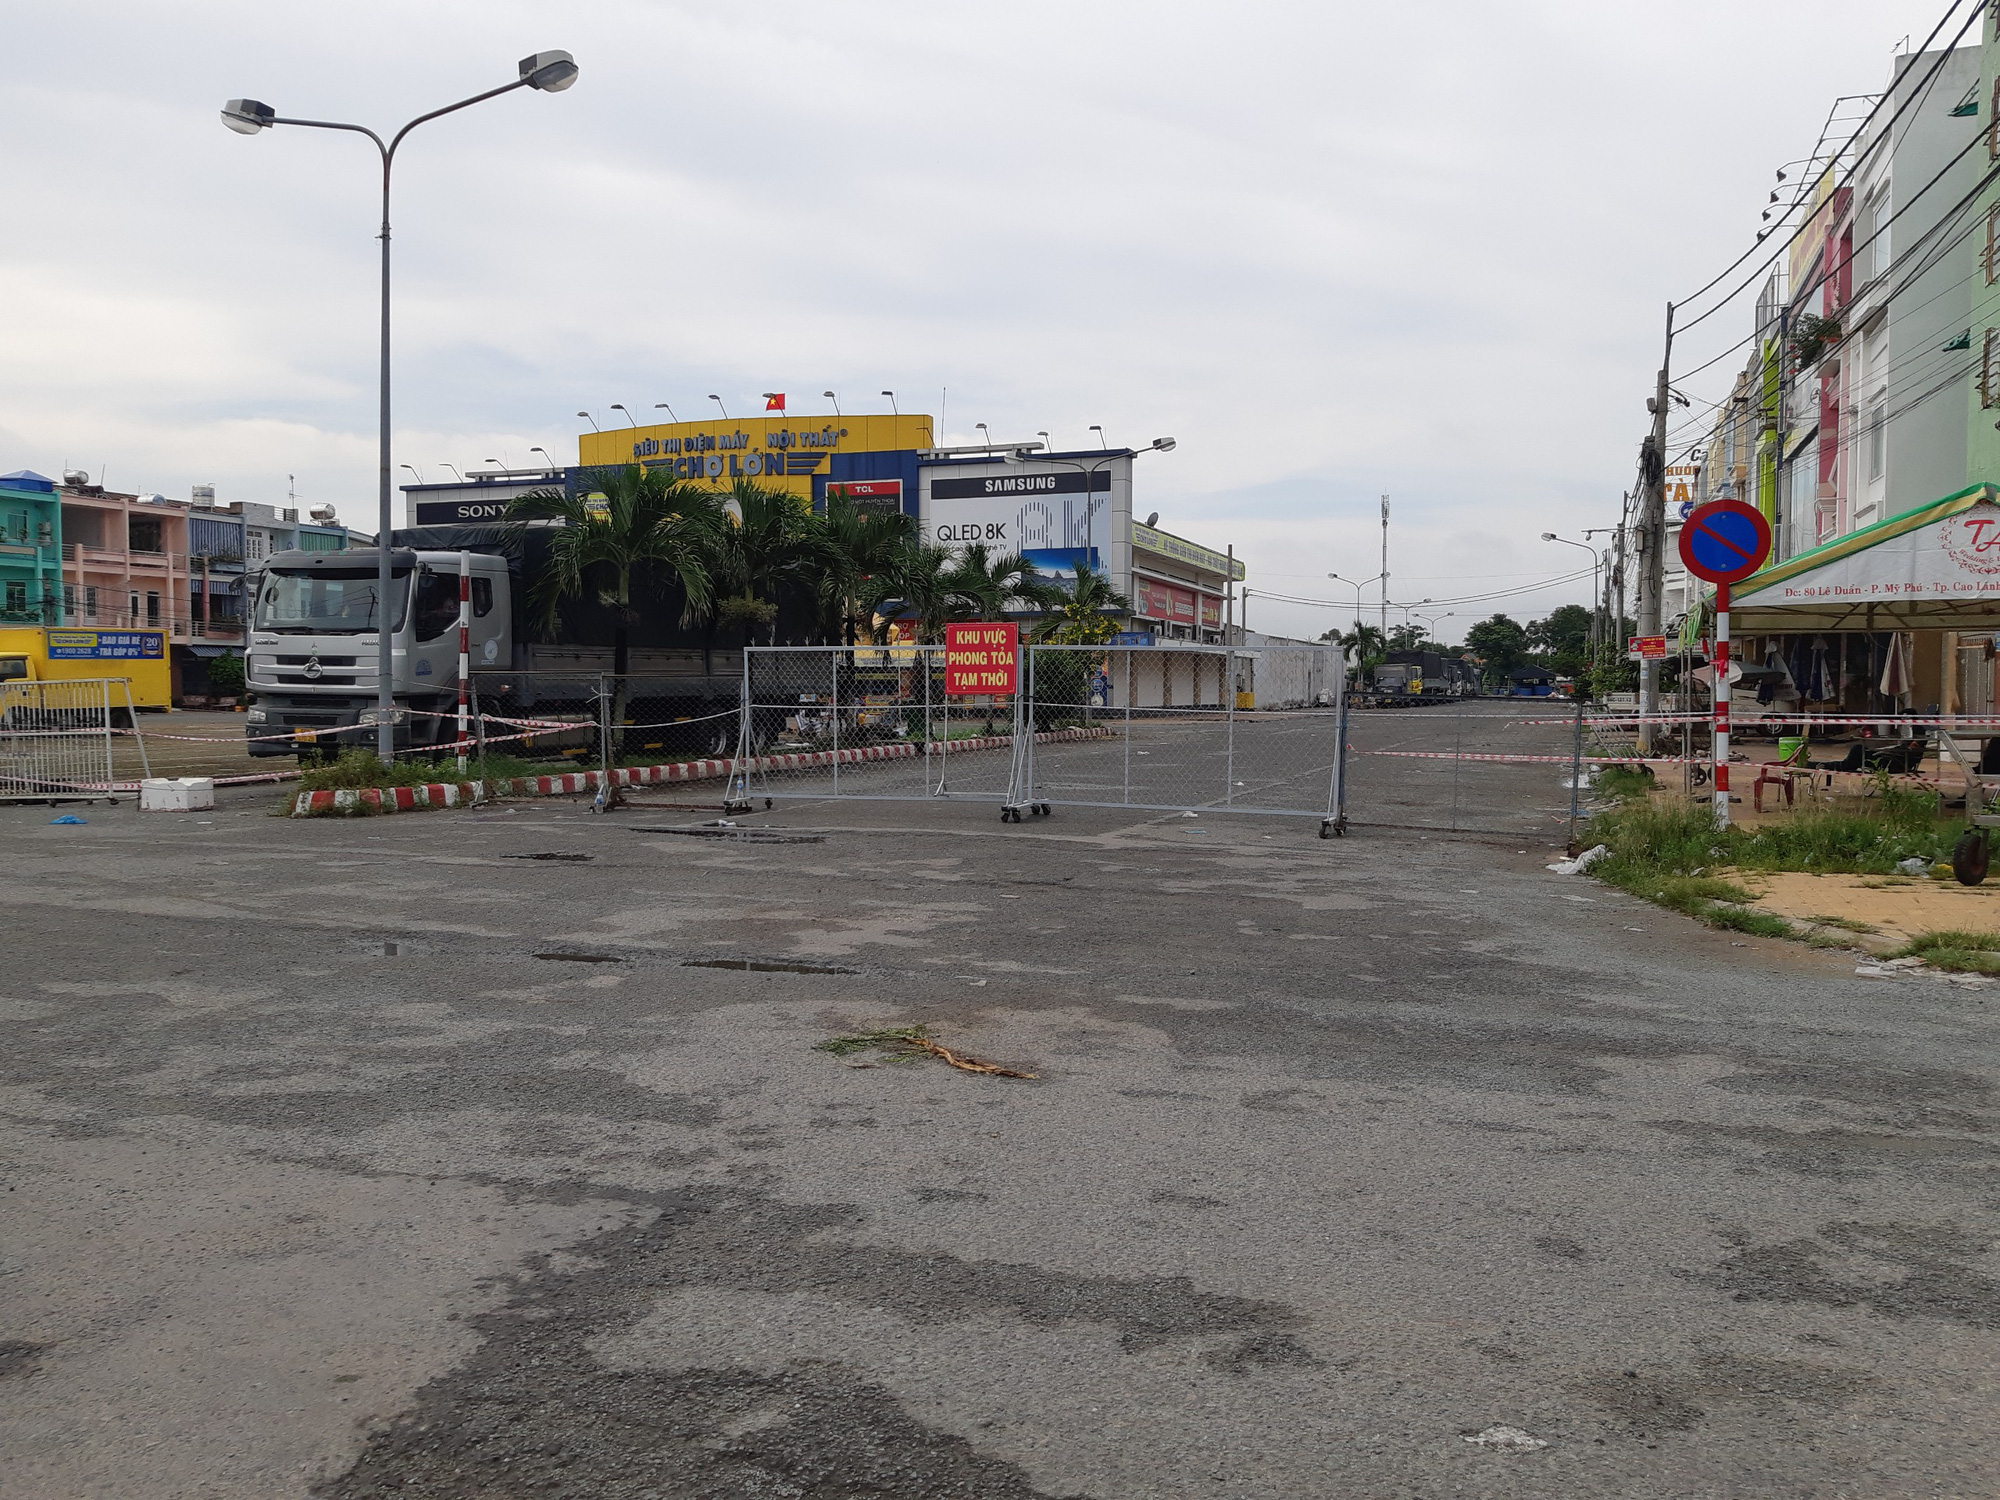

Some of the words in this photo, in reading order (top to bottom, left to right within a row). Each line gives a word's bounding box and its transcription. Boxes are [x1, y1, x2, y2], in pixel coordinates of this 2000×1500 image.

[633, 437, 659, 458] SIÊU
[661, 438, 682, 456] THỊ
[684, 432, 715, 455] ĐIỆN
[718, 430, 750, 450] MÁY
[767, 429, 796, 451] NỘI
[800, 425, 839, 448] THẤT
[672, 453, 724, 484] CHỢ
[728, 447, 786, 478] LỚN
[855, 485, 874, 493] TCL
[984, 476, 1056, 493] SAMSUNG
[458, 505, 507, 518] SONY
[937, 524, 982, 542] QLED
[985, 522, 1007, 540] 8K
[1785, 587, 1801, 597] Đc:
[1804, 587, 1815, 597] 80
[1818, 586, 1831, 596] Lê
[1834, 583, 1861, 596] Duẩn
[1871, 584, 1882, 594] P.
[1884, 582, 1900, 595] Mỹ
[1904, 582, 1923, 593] Phú
[1933, 581, 1950, 594] Tp.
[1953, 581, 1973, 592] Cao
[146, 637, 158, 647] 20
[956, 630, 981, 645] KHU
[983, 627, 1007, 648] VỰC
[948, 651, 988, 666] PHONG
[991, 646, 1014, 666] TỎA
[953, 672, 978, 690] TẠM
[980, 668, 1008, 686] THỜI
